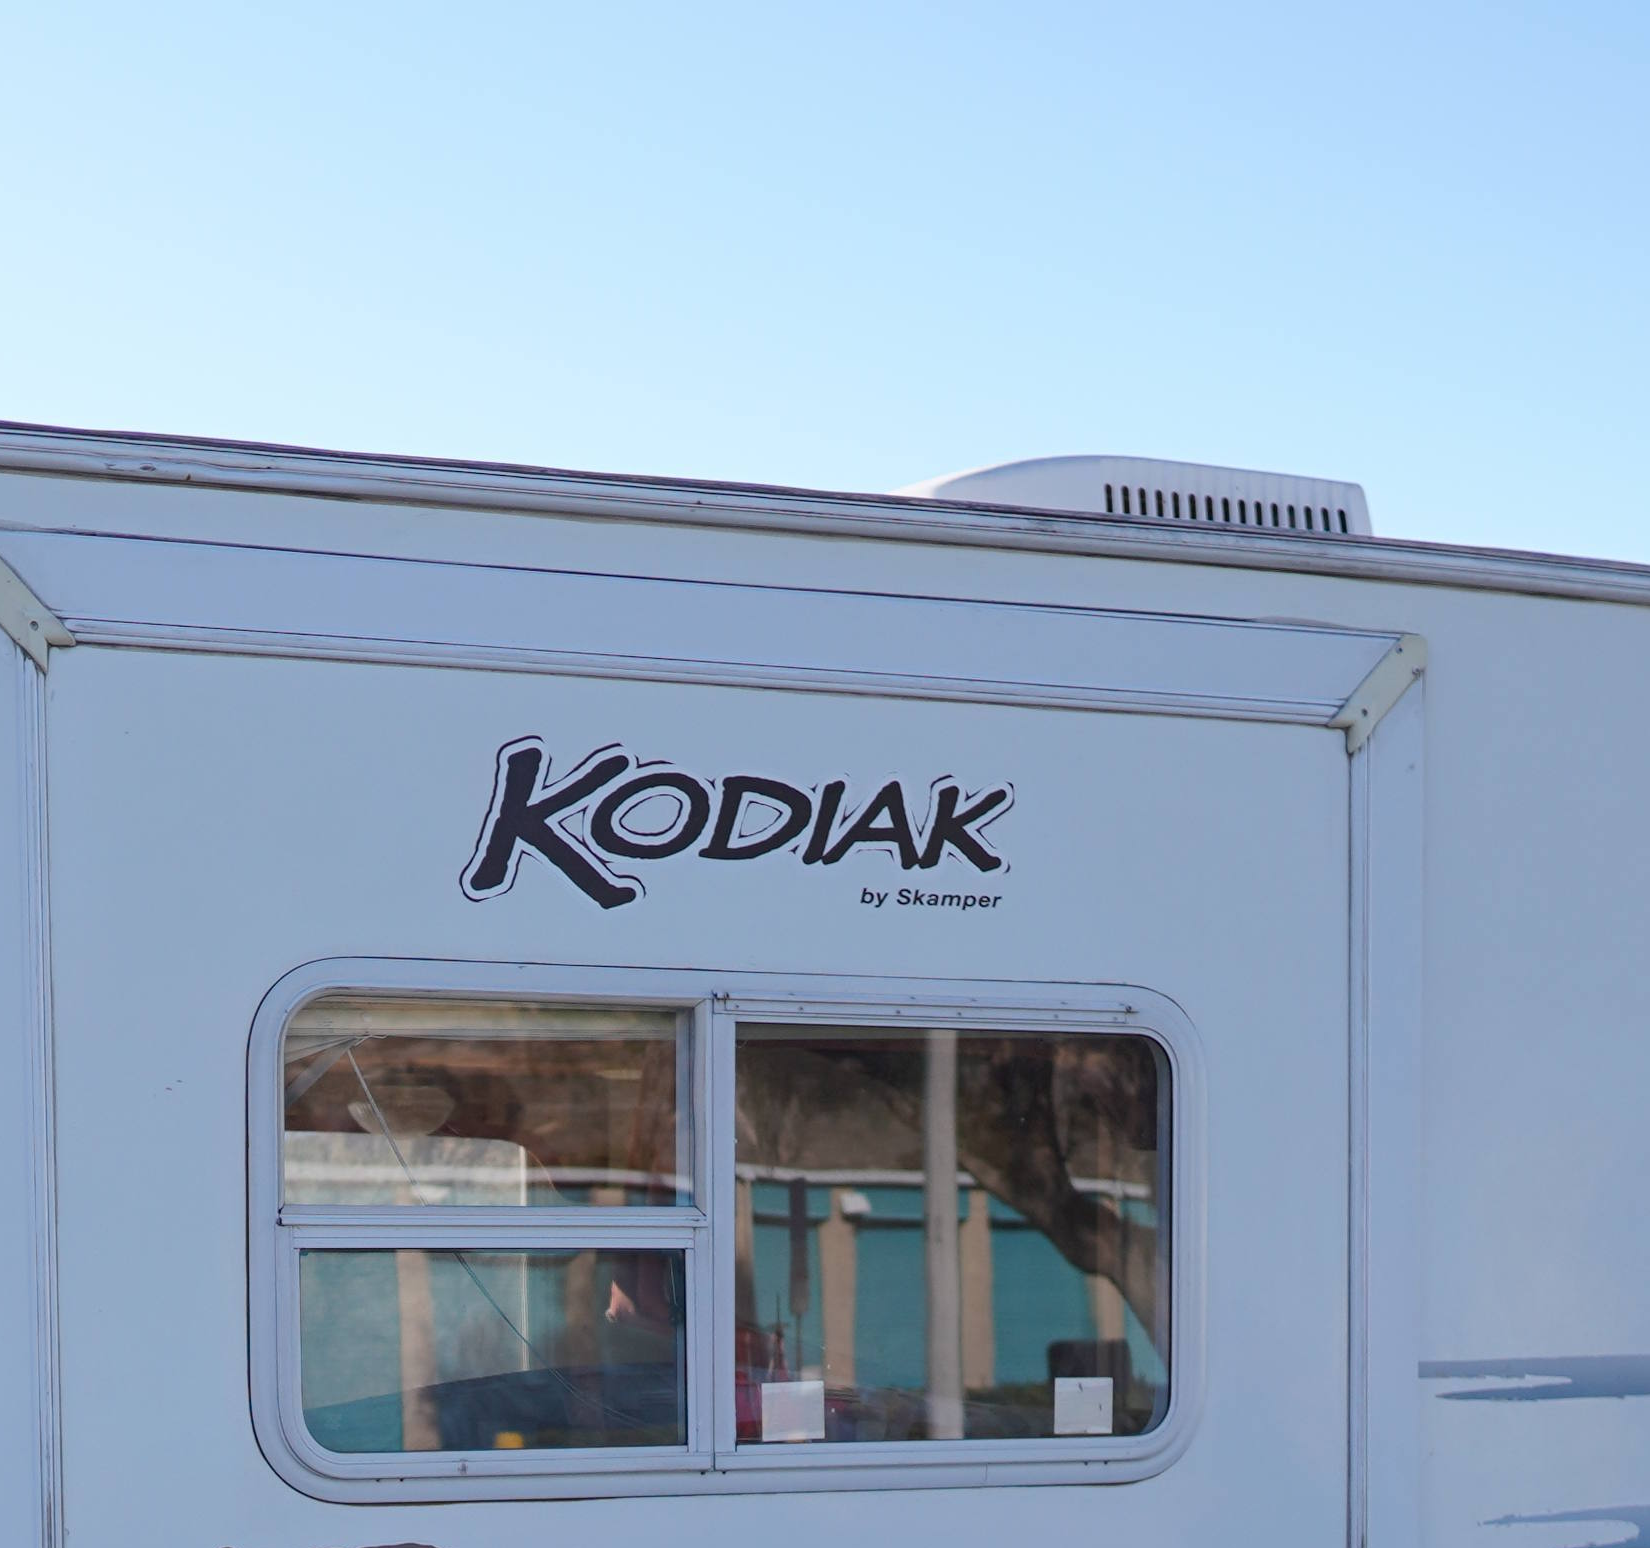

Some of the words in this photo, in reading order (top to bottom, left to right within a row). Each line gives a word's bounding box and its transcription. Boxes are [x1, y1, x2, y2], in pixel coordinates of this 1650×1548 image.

[460, 736, 1014, 909] KODIAK
[860, 888, 889, 908] by
[897, 888, 1002, 910] Skamper
